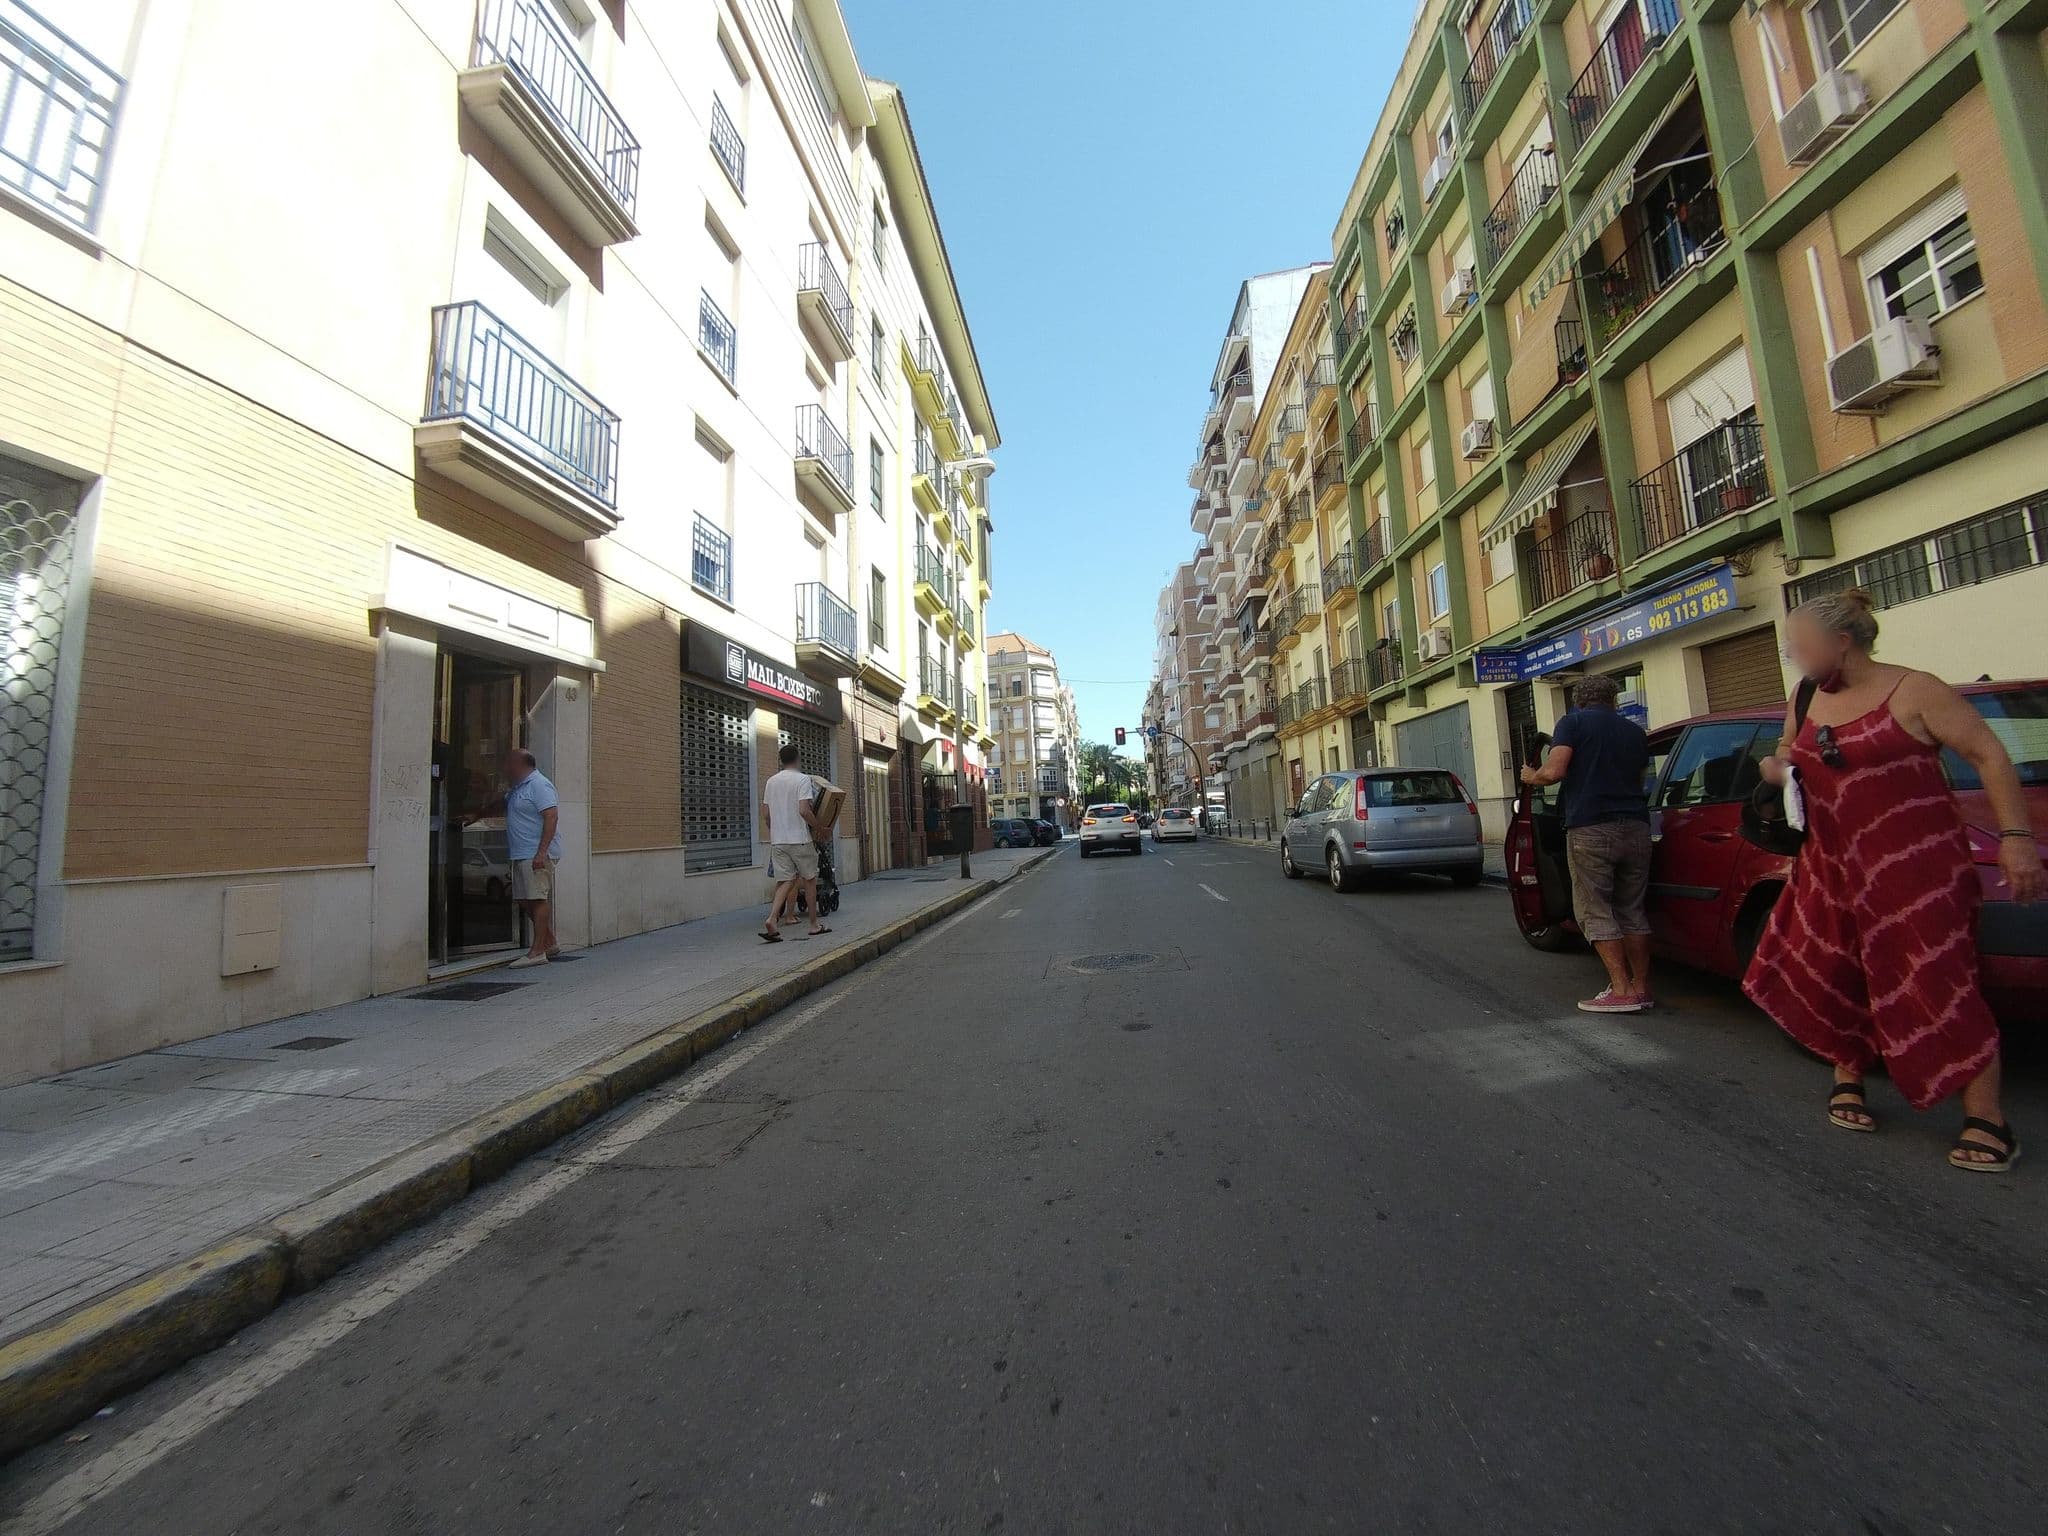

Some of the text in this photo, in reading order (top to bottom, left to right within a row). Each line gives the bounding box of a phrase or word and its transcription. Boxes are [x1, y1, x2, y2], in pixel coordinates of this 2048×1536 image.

[1684, 578, 1718, 598] NACIONAL
[1648, 610, 1672, 632] 902
[1674, 600, 1699, 622] 113
[1701, 588, 1729, 613] 883
[565, 687, 577, 701] 43
[747, 659, 777, 688] MAIL
[777, 672, 805, 701] BOXES
